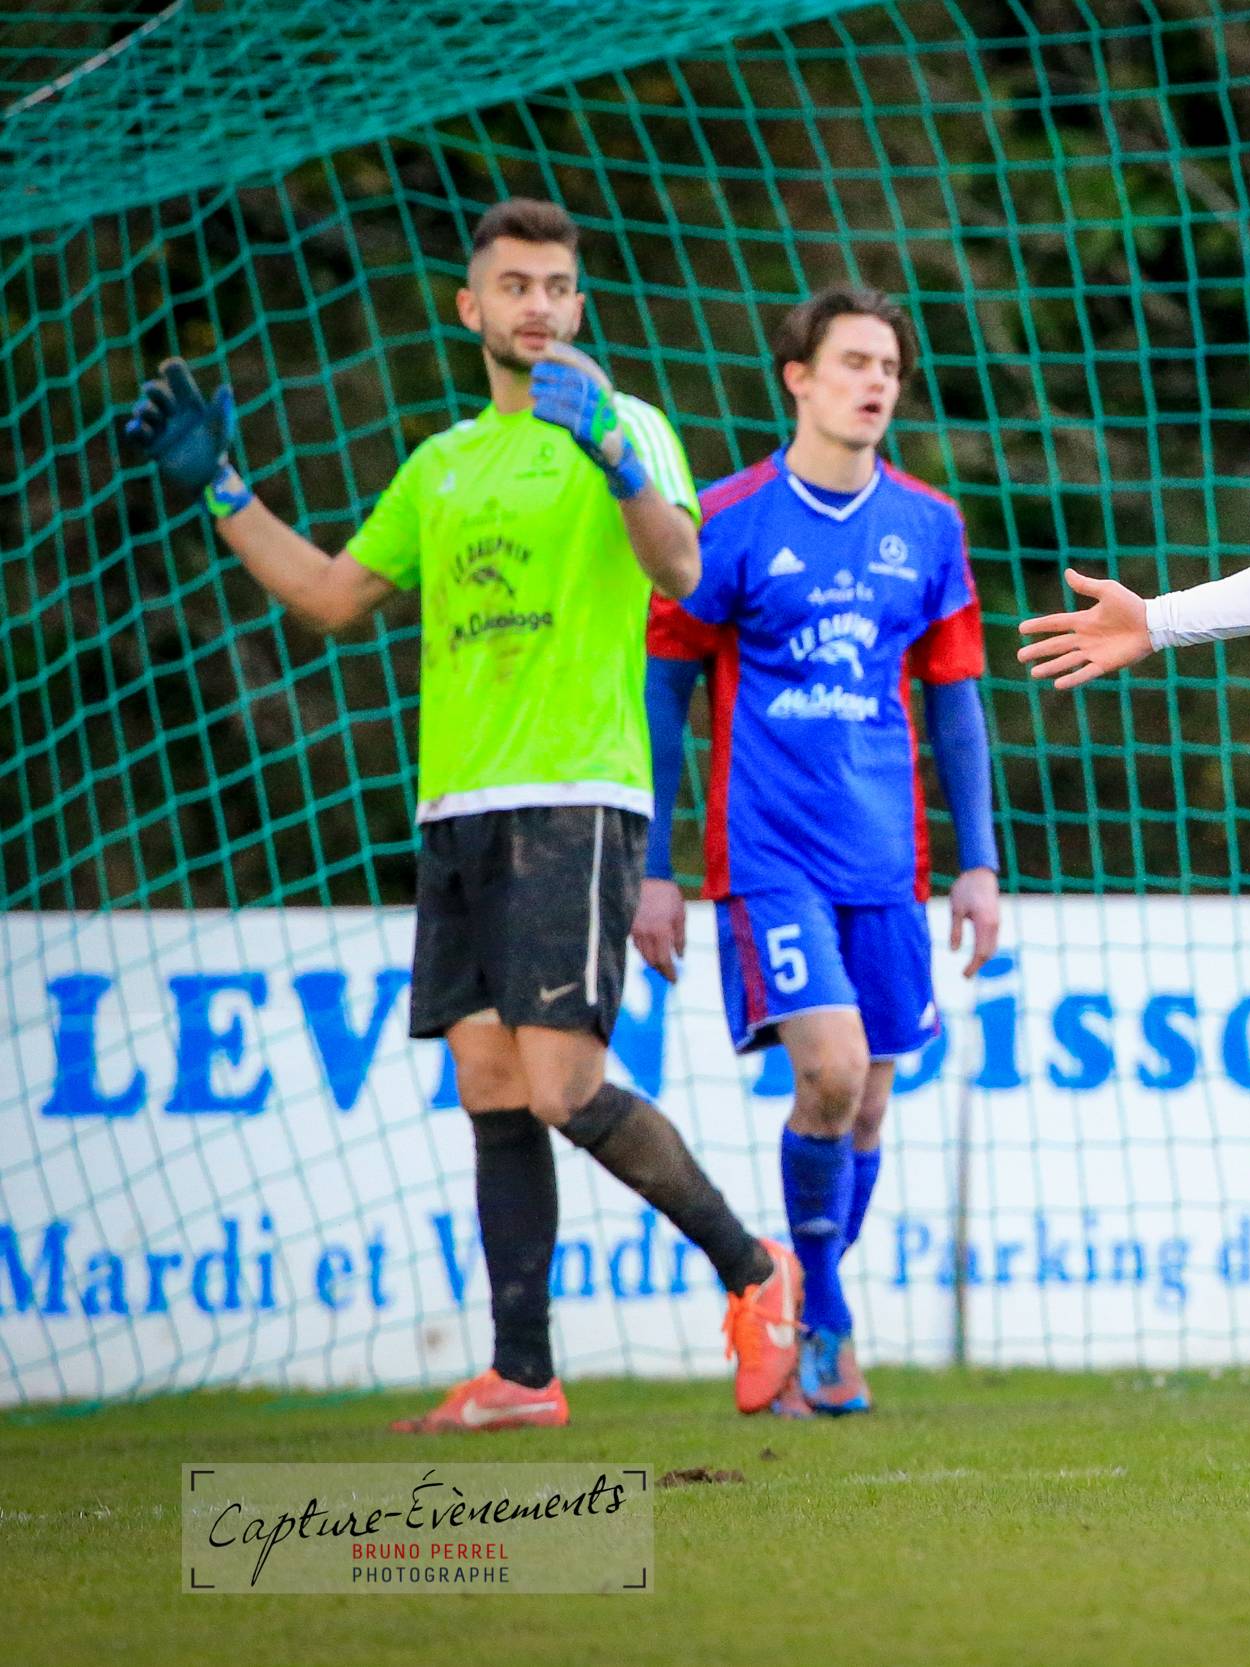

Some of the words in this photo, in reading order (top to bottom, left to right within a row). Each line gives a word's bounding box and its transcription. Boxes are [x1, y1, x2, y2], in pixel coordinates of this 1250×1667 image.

[766, 923, 809, 994] 5
[42, 966, 672, 1116] LEVN
[0, 1214, 275, 1313] Mardi
[315, 1233, 387, 1309] et
[892, 1212, 1190, 1305] Parking
